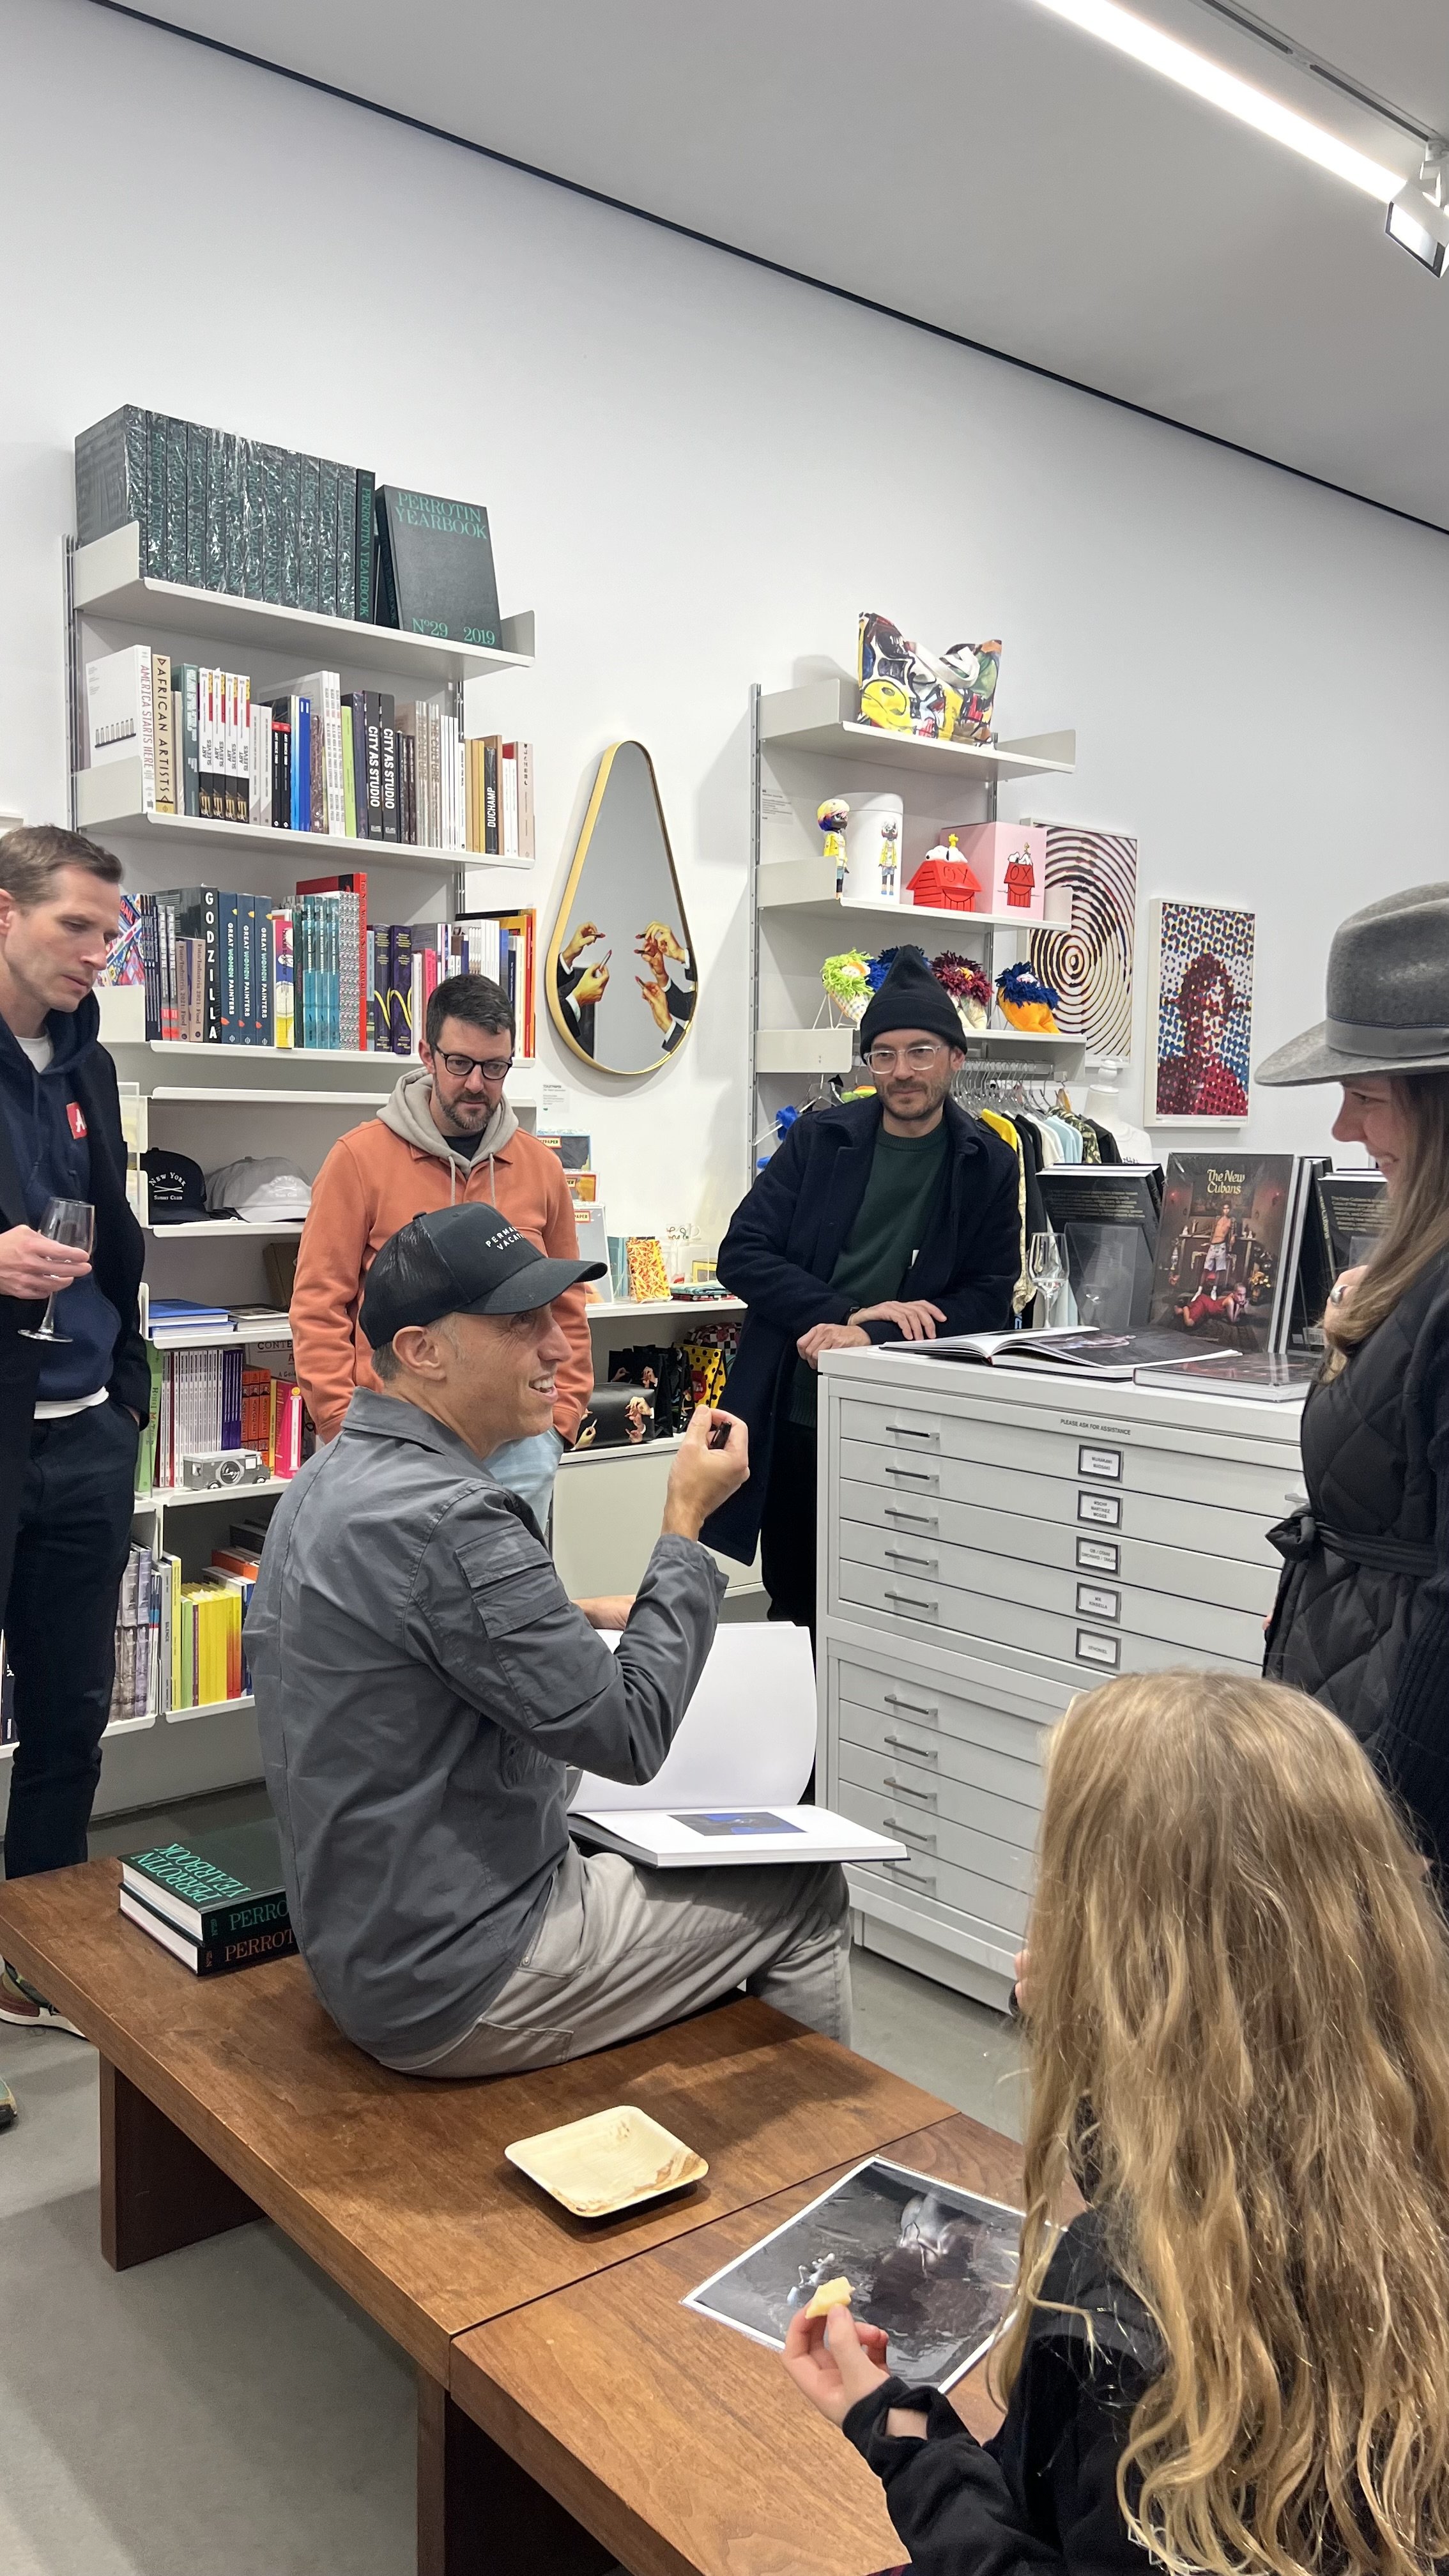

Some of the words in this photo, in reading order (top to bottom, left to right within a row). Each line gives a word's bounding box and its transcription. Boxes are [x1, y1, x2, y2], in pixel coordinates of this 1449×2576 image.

[360, 487, 371, 547] PERROTIN
[395, 507, 487, 539] YEARBOOK
[397, 491, 482, 523] PERROTIN
[359, 549, 371, 618] YEARBOOK
[463, 626, 496, 646] 2019
[141, 664, 151, 707] AMERICA
[157, 667, 169, 732] AFRICAN
[142, 710, 153, 744] STARTS
[368, 726, 378, 751] CITY
[383, 728, 394, 753] CITY
[143, 746, 154, 769] HERE
[158, 738, 170, 792] ARTISTS
[369, 750, 379, 767] AS
[384, 752, 394, 769] AS
[369, 768, 380, 808] STUDIO
[385, 770, 395, 809] STUDIO
[487, 786, 496, 828] DUCHAMP
[205, 892, 218, 1039] GODZILLA
[170, 1172, 187, 1186] YORK
[1207, 1169, 1223, 1182] The
[1224, 1170, 1245, 1183] New
[1208, 1181, 1241, 1194] Cubans
[1061, 1418, 1078, 1427] PLEASE
[1100, 1425, 1131, 1436] ASSISTANCE
[130, 1851, 222, 1903] PERROTIN
[153, 1843, 252, 1898] YEARBOOK
